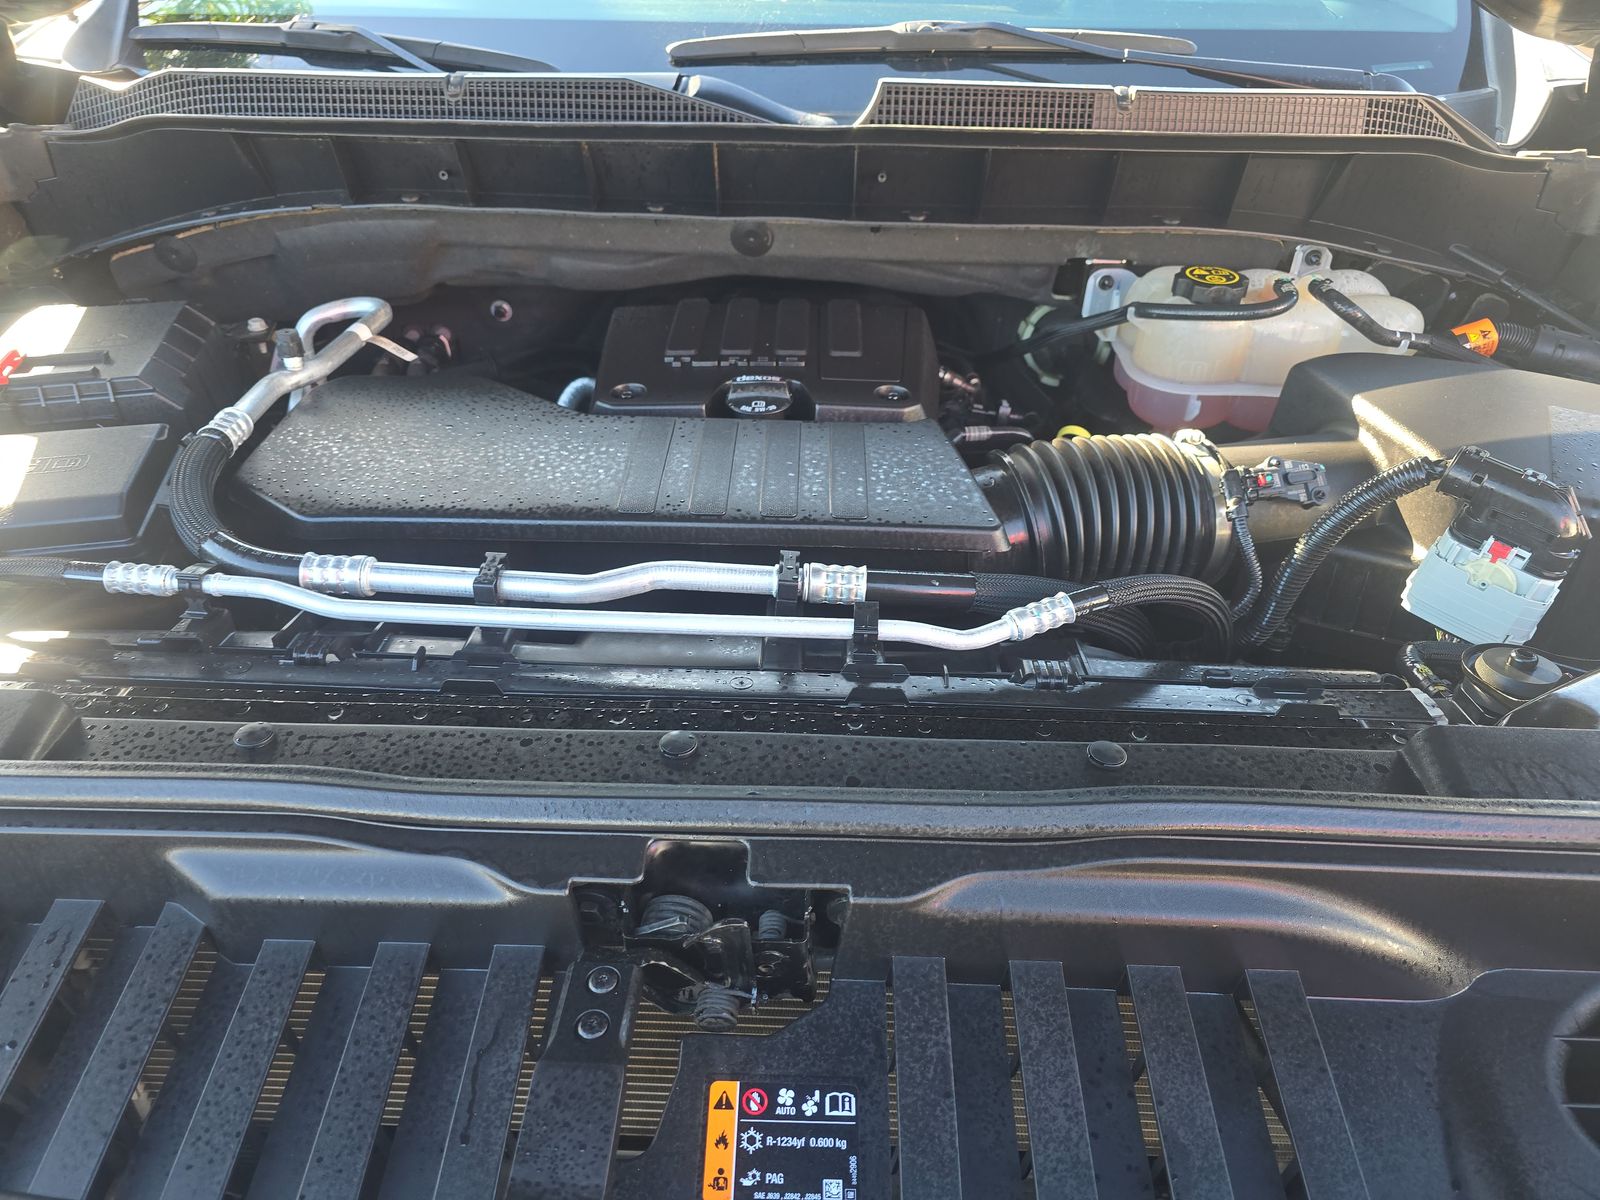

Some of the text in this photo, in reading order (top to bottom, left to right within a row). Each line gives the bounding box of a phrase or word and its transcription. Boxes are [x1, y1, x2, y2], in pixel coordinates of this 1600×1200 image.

[775, 1106, 796, 1116] AUTO
[766, 1136, 847, 1150] R-1234yf 0.600 kg
[765, 1172, 784, 1184] PAG
[753, 1191, 766, 1200] SAE
